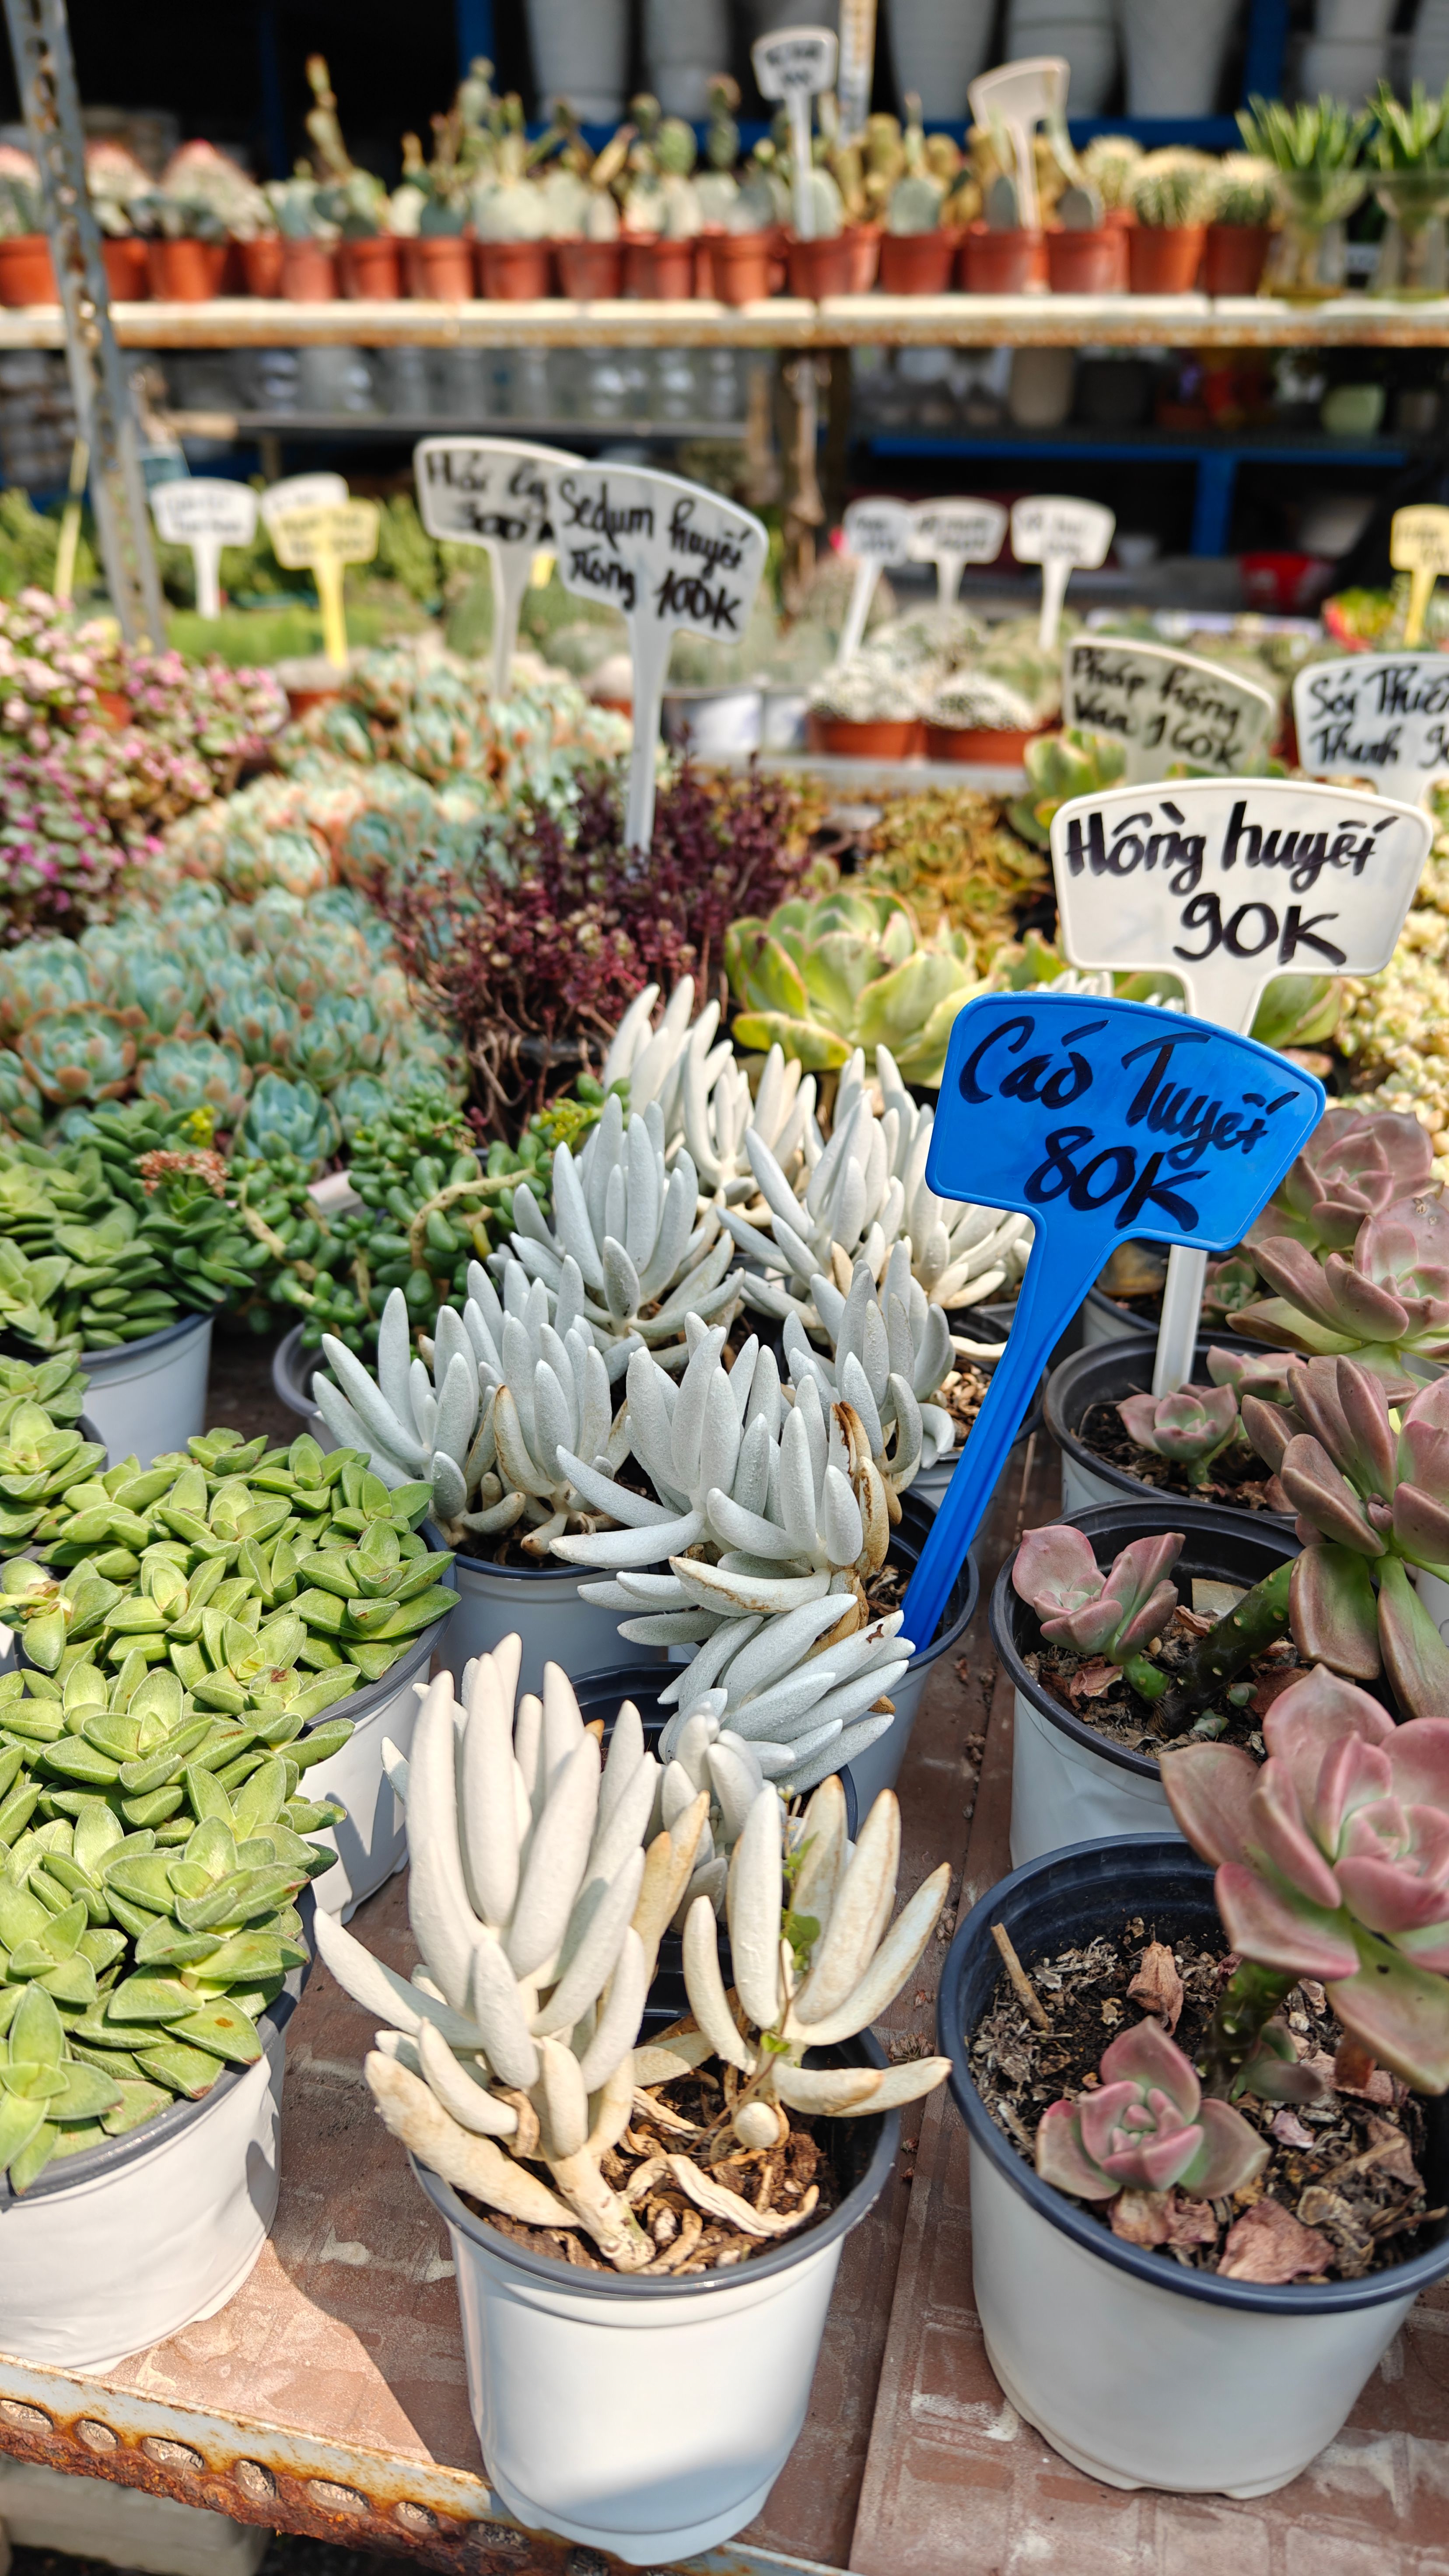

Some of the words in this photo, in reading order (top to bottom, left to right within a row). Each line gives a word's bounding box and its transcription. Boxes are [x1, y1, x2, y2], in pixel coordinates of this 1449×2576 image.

[655, 568, 740, 630] 100K
[1065, 802, 1206, 896] Hồng
[1173, 892, 1347, 965] 90K
[1024, 1126, 1211, 1232] 80K
